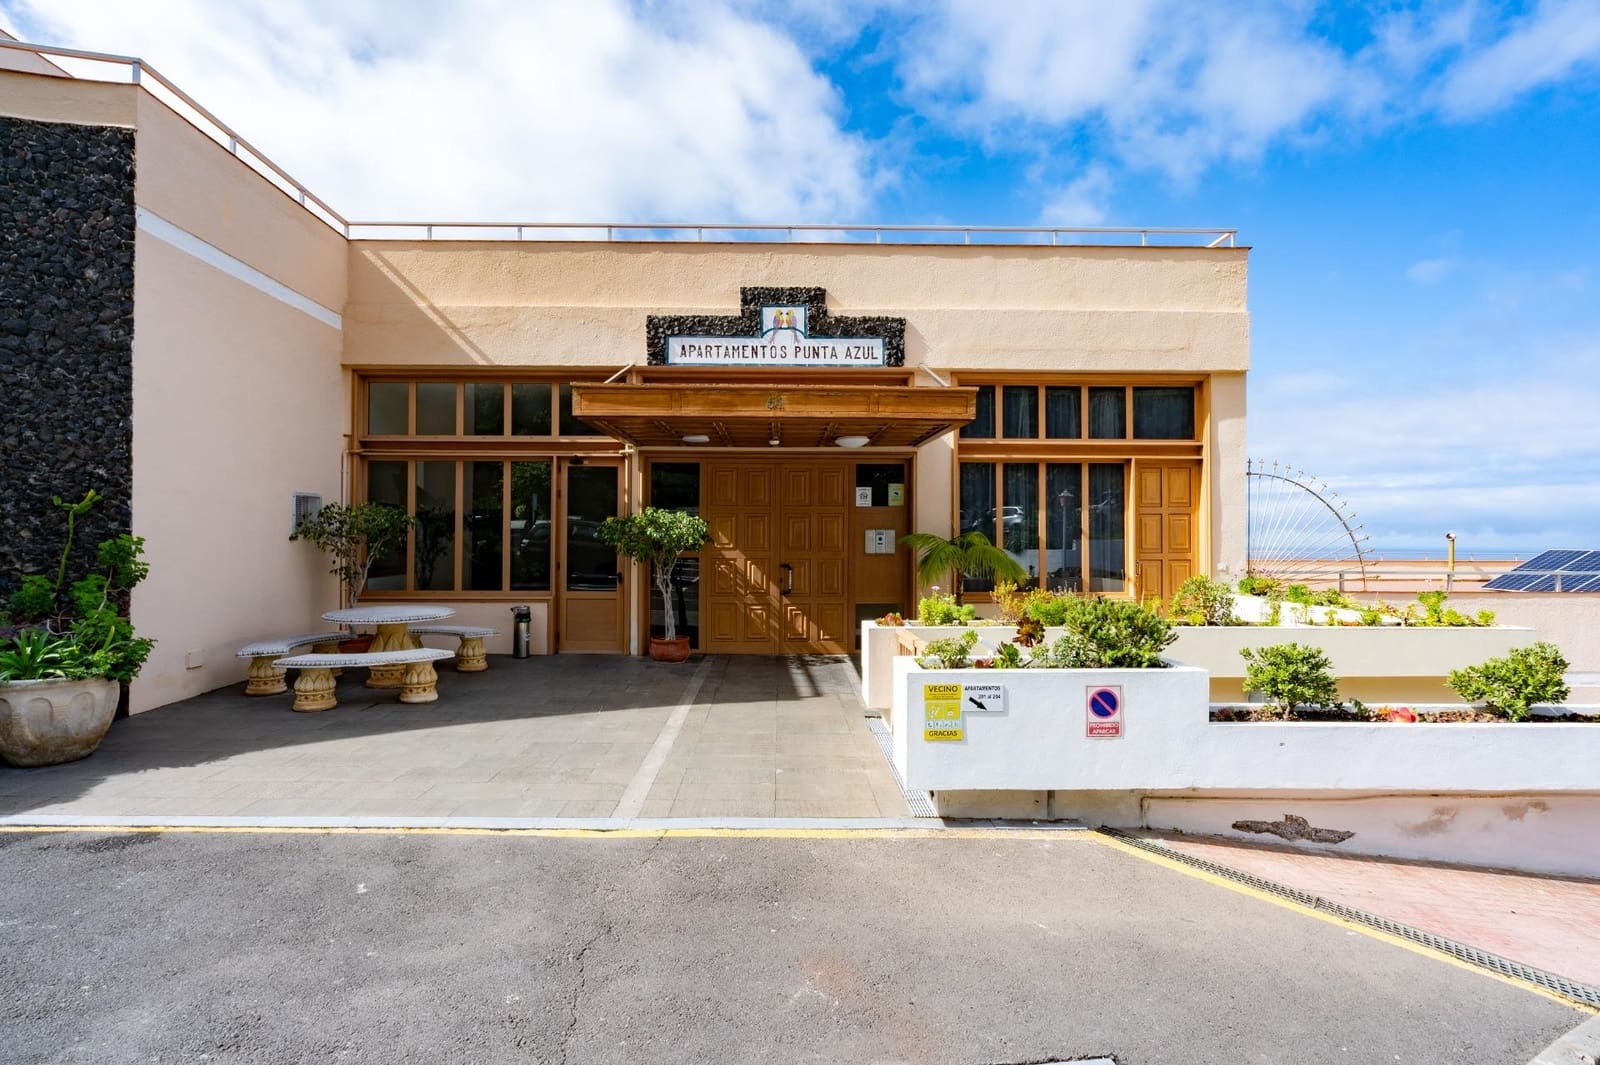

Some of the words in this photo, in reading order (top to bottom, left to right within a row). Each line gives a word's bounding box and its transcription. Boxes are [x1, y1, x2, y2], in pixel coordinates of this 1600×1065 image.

[680, 344, 788, 359] APARTAMENTOS
[794, 345, 838, 359] PUNTA
[845, 345, 879, 360] AZUL
[928, 685, 958, 693] VECINO
